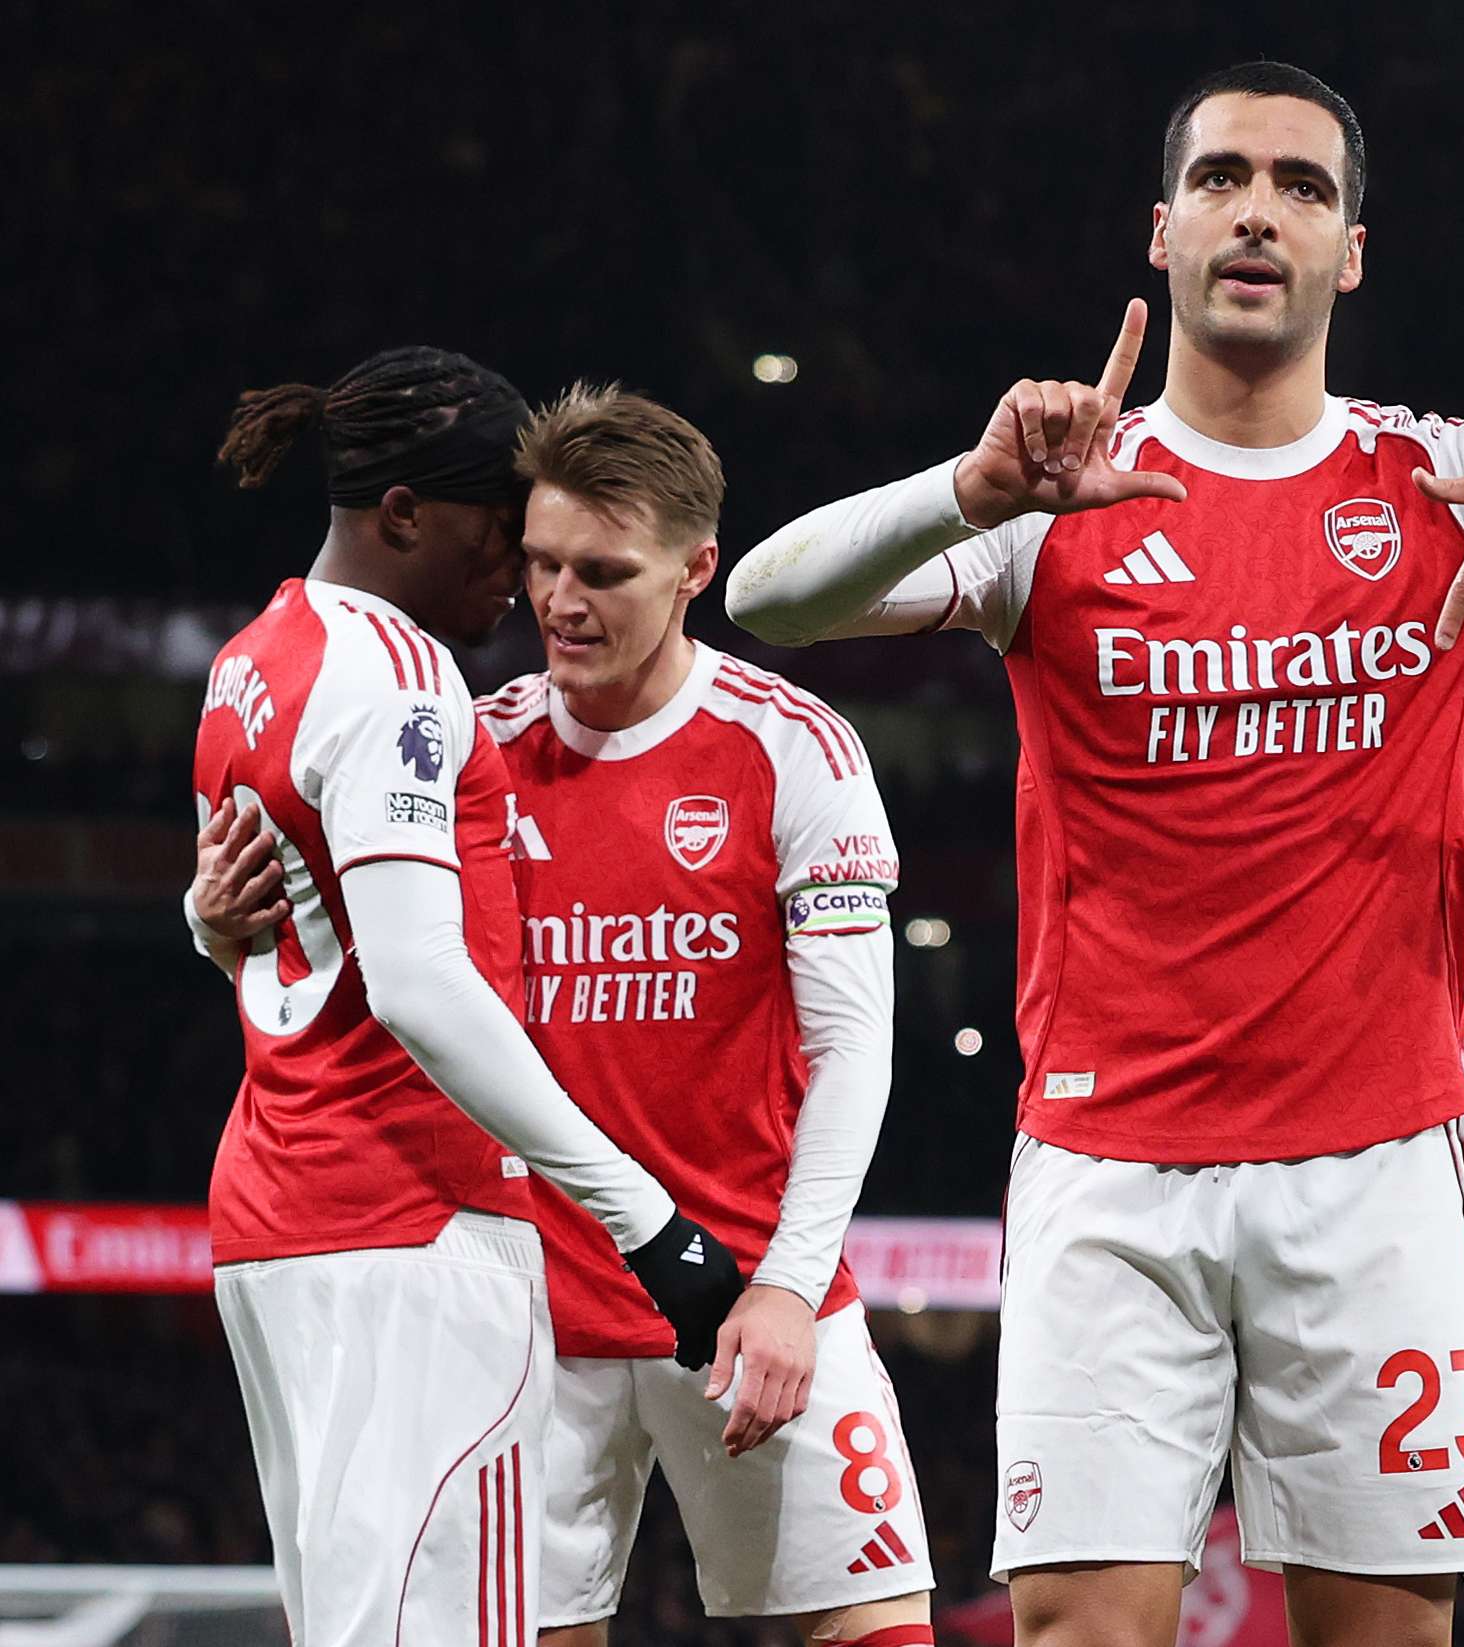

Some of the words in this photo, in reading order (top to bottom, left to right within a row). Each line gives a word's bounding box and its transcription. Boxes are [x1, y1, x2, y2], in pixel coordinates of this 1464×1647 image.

[1336, 514, 1388, 530] Arsenal
[1094, 620, 1432, 697] Emirates
[1147, 704, 1219, 764] FLY
[1235, 693, 1387, 758] BETTER
[386, 793, 412, 809] No
[676, 809, 720, 821] Arsenal
[832, 835, 881, 857] VISIT
[813, 892, 887, 912] Capta
[524, 902, 740, 965] mirates
[526, 976, 562, 1023] LY
[571, 971, 697, 1023] BETTER
[833, 1411, 902, 1513] 8
